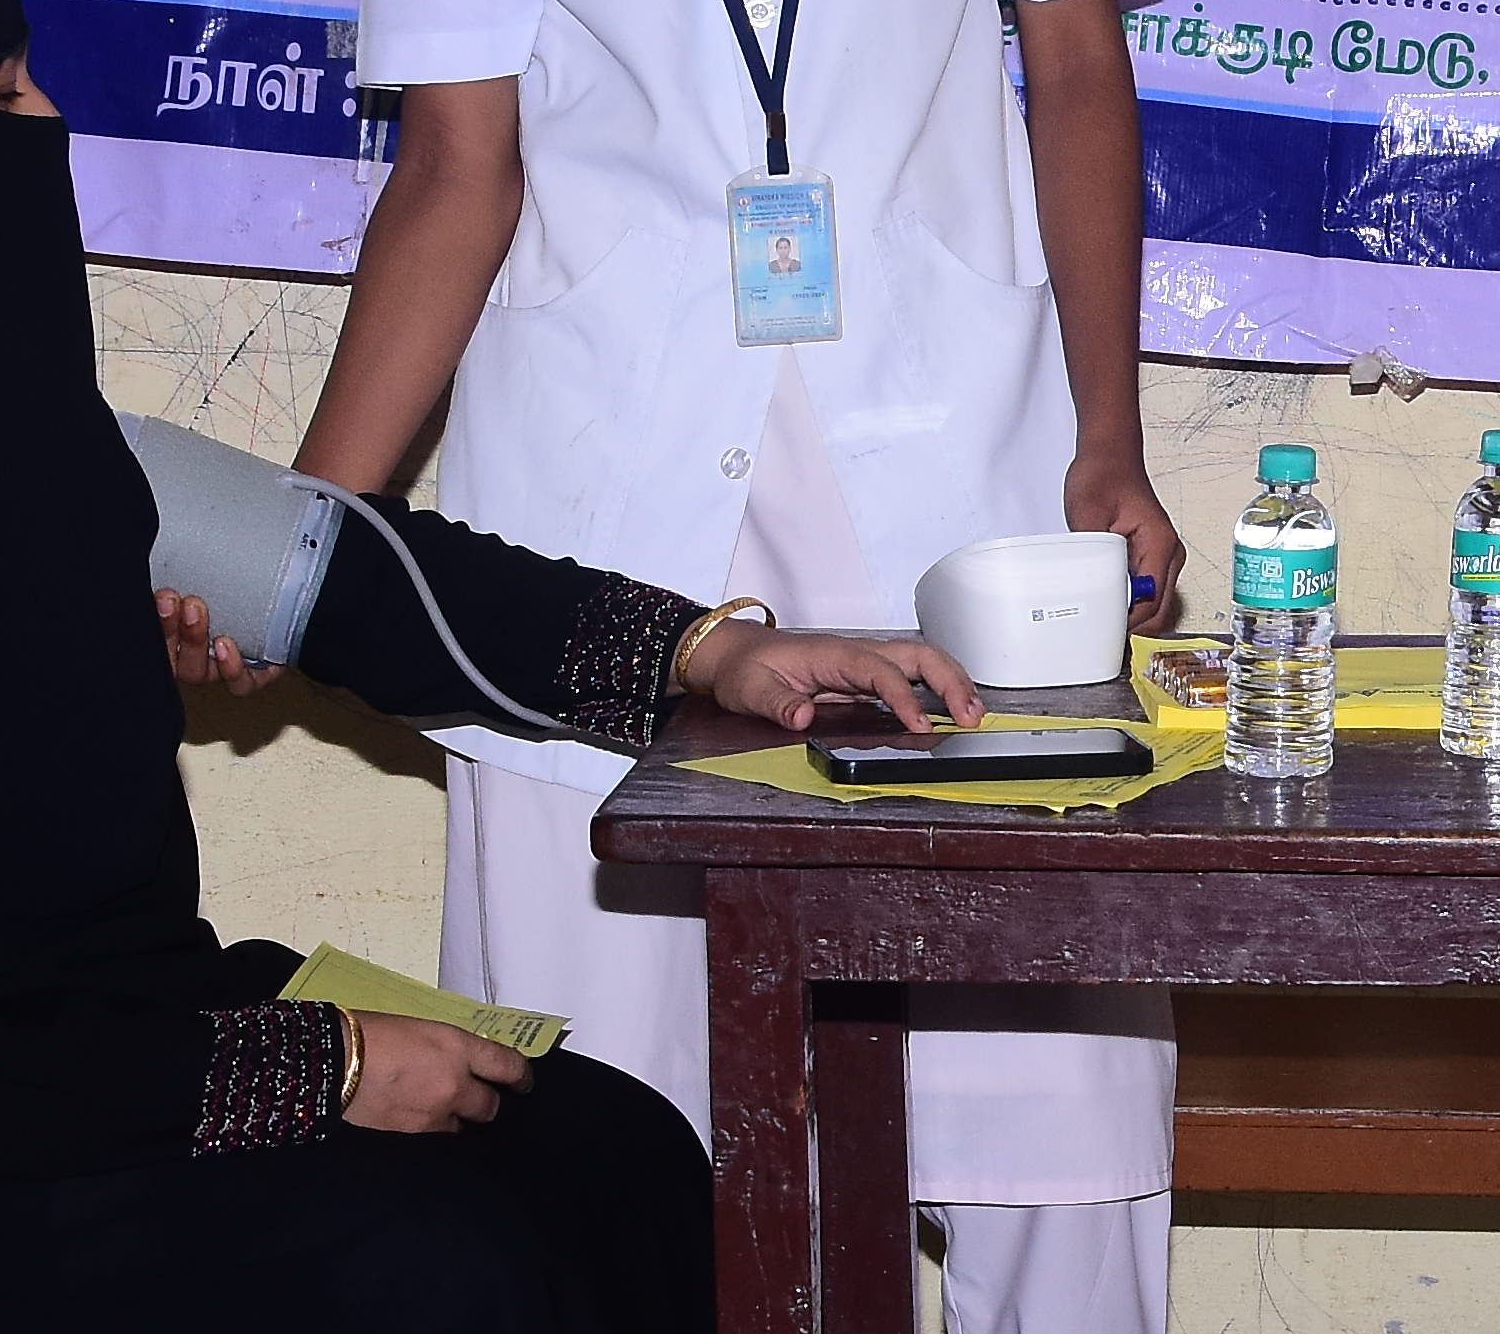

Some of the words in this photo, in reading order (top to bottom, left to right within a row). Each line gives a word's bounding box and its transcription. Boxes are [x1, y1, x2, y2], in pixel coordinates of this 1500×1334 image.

[156, 42, 324, 117] நாள்
[1331, 20, 1490, 89] மேடு,
[1291, 567, 1335, 599] Bisw
